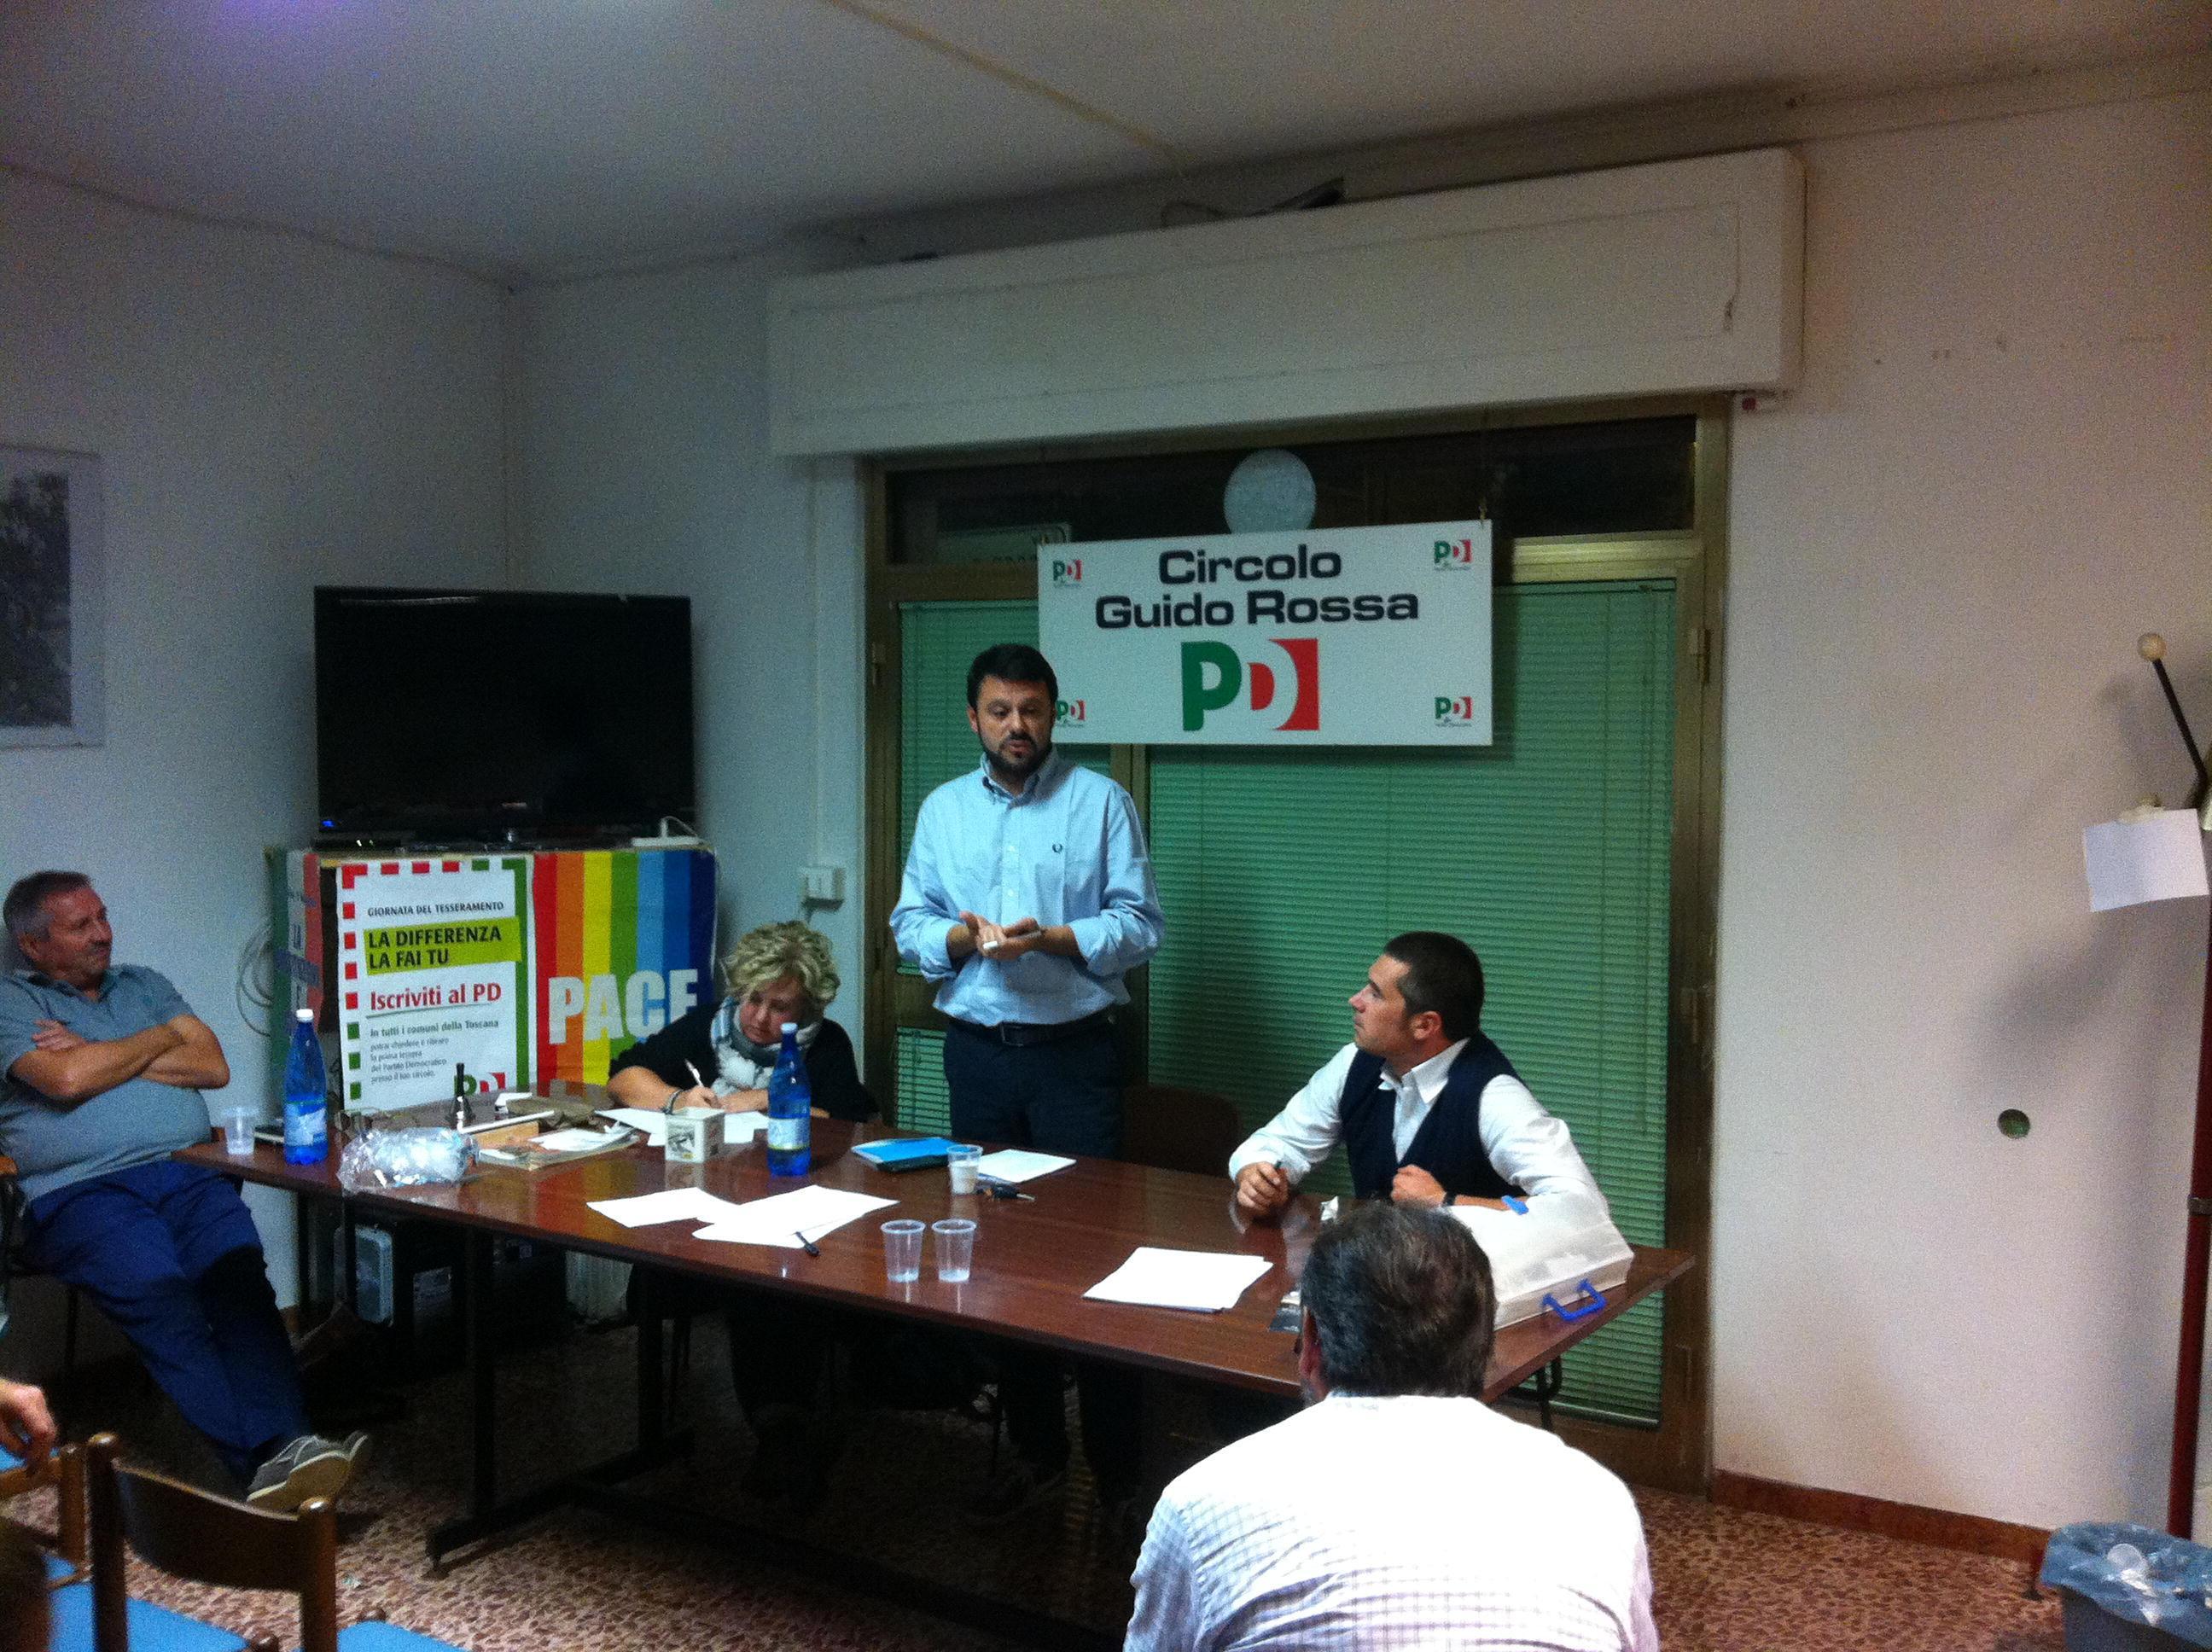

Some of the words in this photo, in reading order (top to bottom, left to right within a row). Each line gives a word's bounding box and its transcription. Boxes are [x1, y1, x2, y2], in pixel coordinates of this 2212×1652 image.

[1158, 544, 1342, 585] Circolo
[1095, 594, 1234, 630] Guido
[1247, 590, 1420, 625] Rossa
[1181, 638, 1319, 731] PD
[368, 905, 414, 917] GIORNATA
[416, 905, 432, 915] DEL
[435, 901, 504, 914] TESSERAMENTO
[369, 931, 391, 948] LA
[395, 926, 502, 947] DIFFERENZA
[369, 951, 391, 969] LA
[395, 950, 422, 967] FAI
[427, 949, 450, 965] TU
[370, 985, 441, 1010] Iscriviti
[448, 983, 466, 1004] al
[473, 982, 502, 1003] PD
[381, 1027, 399, 1037] tutti
[407, 1023, 439, 1034] comuni
[441, 1021, 463, 1032] della
[464, 1020, 499, 1029] Toscana
